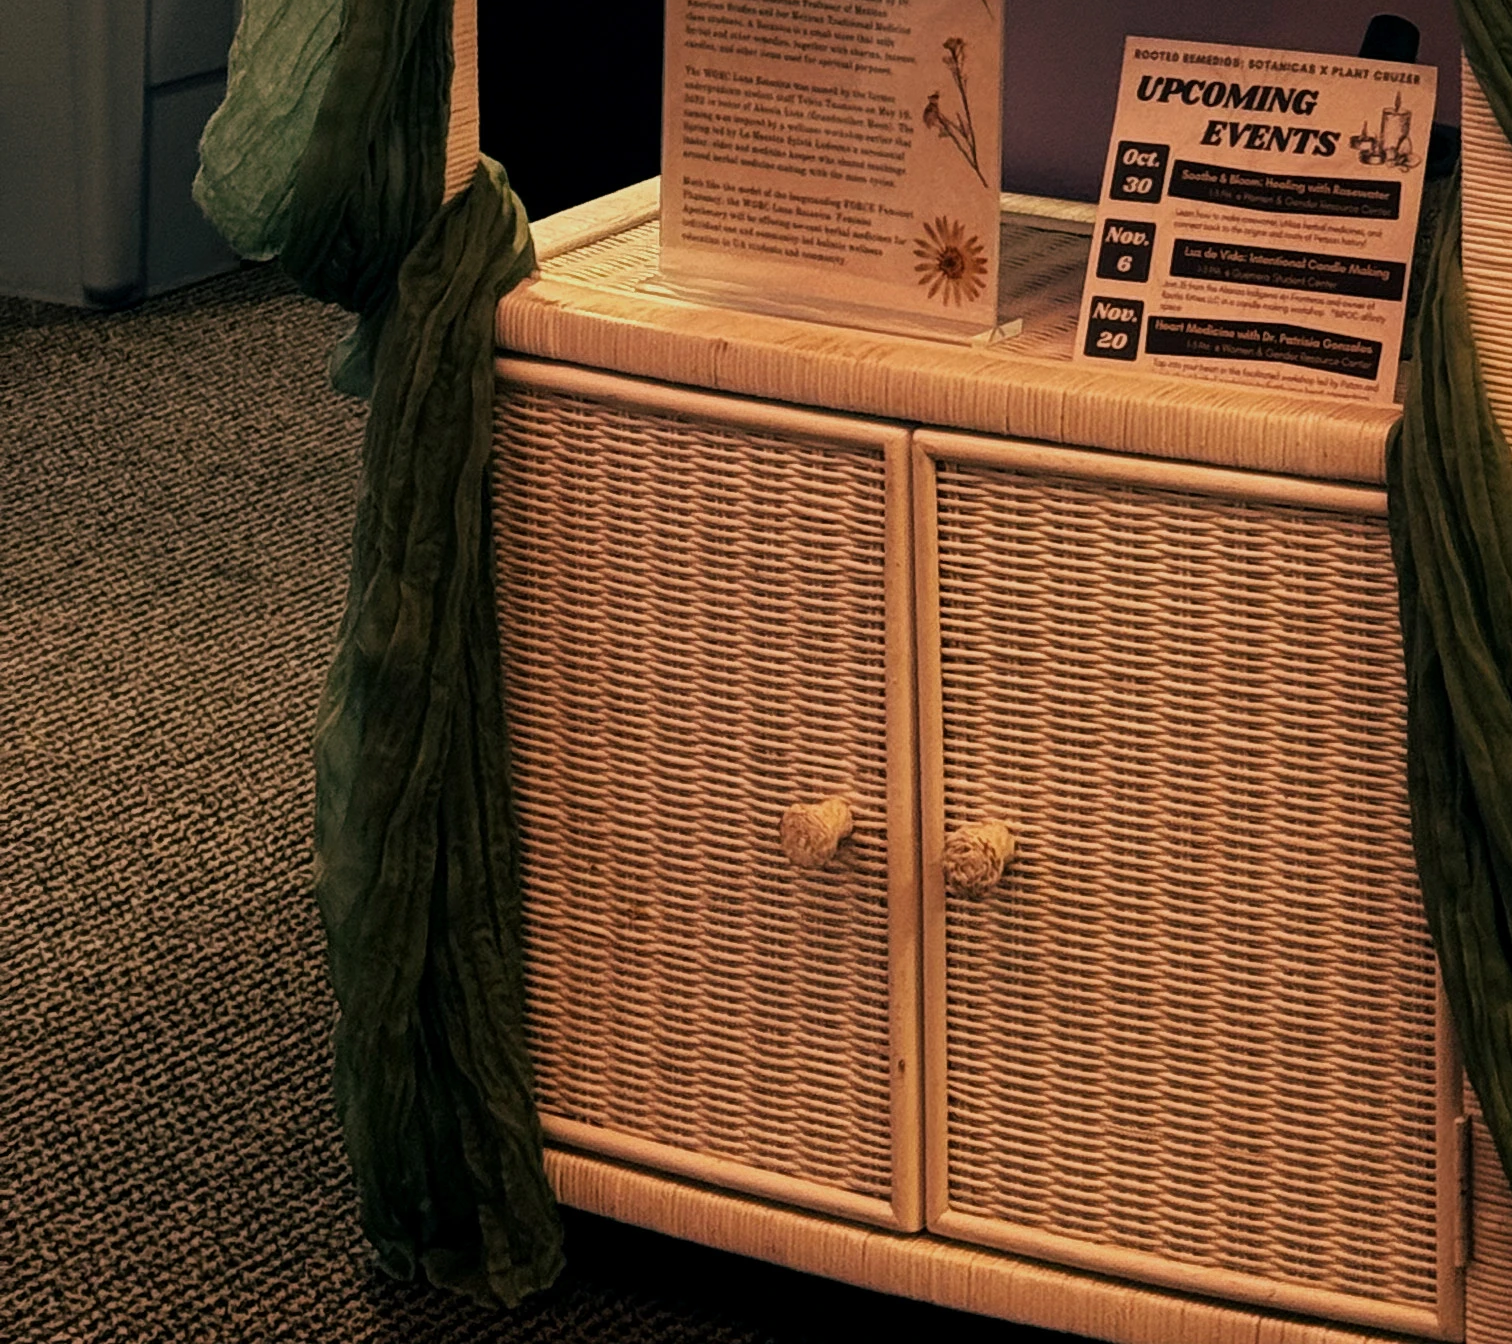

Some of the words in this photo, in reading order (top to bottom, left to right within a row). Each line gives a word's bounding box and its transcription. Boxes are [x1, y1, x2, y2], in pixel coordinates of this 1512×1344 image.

[1133, 48, 1179, 62] ROOTED
[1247, 58, 1316, 75] BOTANICAS
[1319, 65, 1328, 76] X
[1330, 66, 1369, 80] PLANT
[1136, 74, 1319, 116] UPCOMING
[1200, 119, 1341, 158] EVENTS
[1122, 148, 1161, 168] Oct.
[1122, 176, 1153, 195] 30
[1104, 225, 1150, 247] Nov.
[1116, 255, 1132, 273] 6
[1093, 302, 1138, 324] Nov.
[1096, 332, 1128, 351] 20
[1154, 318, 1184, 333] Heart
[1185, 321, 1235, 339] Medicine
[1236, 327, 1261, 342] with
[1261, 330, 1277, 344] Dr.
